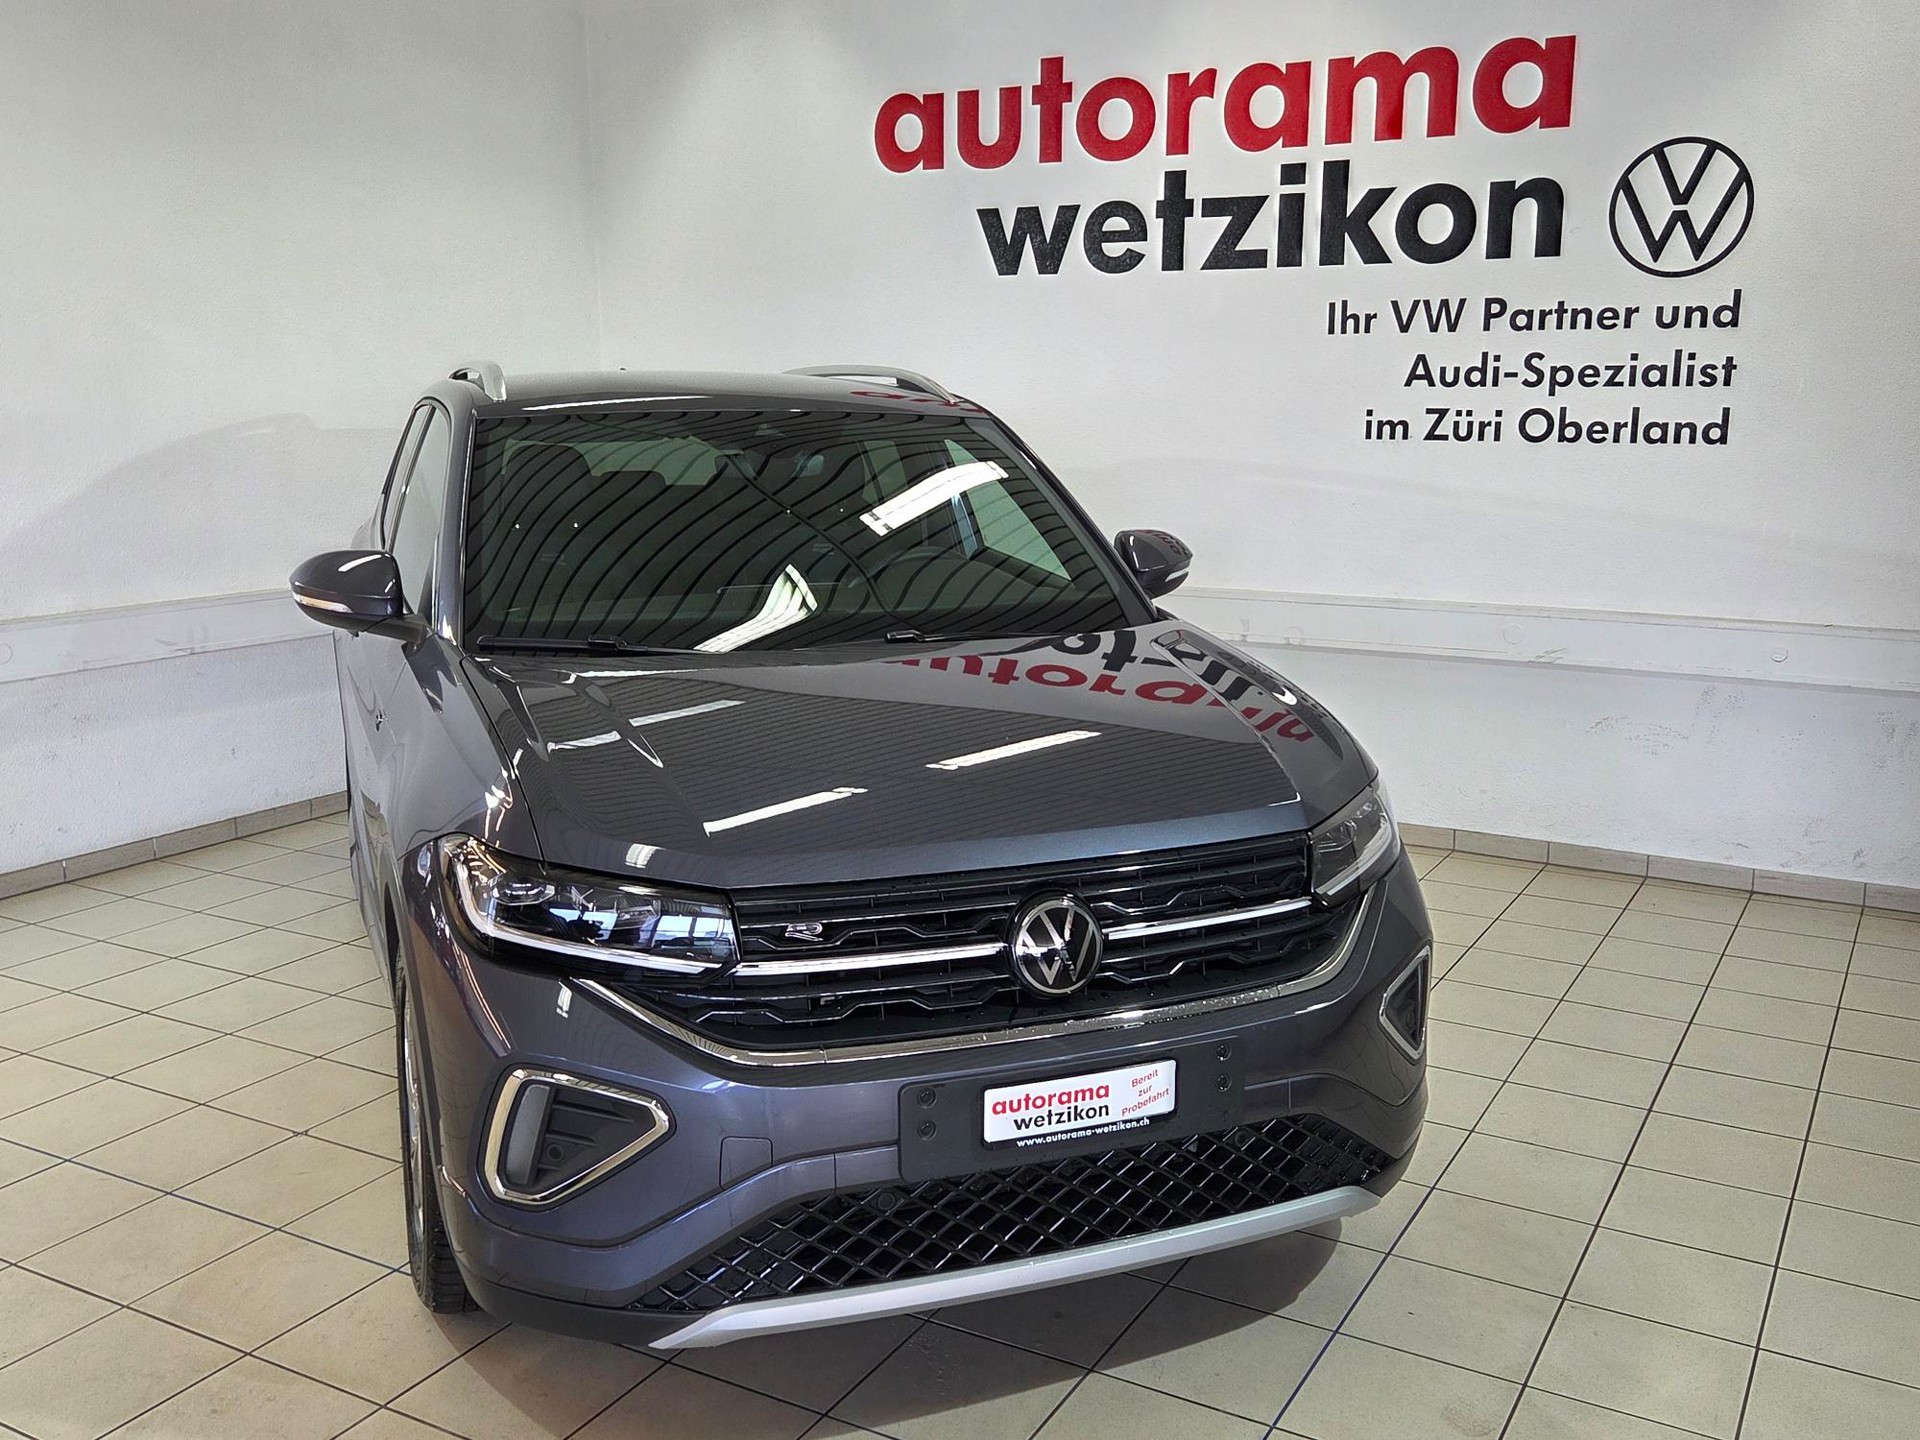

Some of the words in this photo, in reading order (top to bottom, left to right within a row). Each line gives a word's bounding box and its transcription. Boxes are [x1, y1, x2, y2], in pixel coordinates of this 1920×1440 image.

[875, 35, 1577, 173] autorama
[977, 160, 1565, 276] wetzikon
[1327, 299, 1378, 335] Ihr
[1390, 297, 1467, 334] VW
[1482, 297, 1640, 332] Partner
[1655, 288, 1743, 330] und
[1403, 348, 1738, 397] Audi-Spezialist
[1365, 409, 1410, 441] im
[1422, 407, 1503, 442] Züri
[1518, 406, 1731, 446] Oberland
[1131, 1069, 1159, 1088] Bereit
[1138, 1084, 1152, 1097] zur
[991, 1084, 1110, 1115] autorama
[1121, 1087, 1169, 1116] Probefahrt
[1013, 1103, 1110, 1131] wetzikon
[1016, 1117, 1150, 1148] www.autorama-wetzikon.ch
